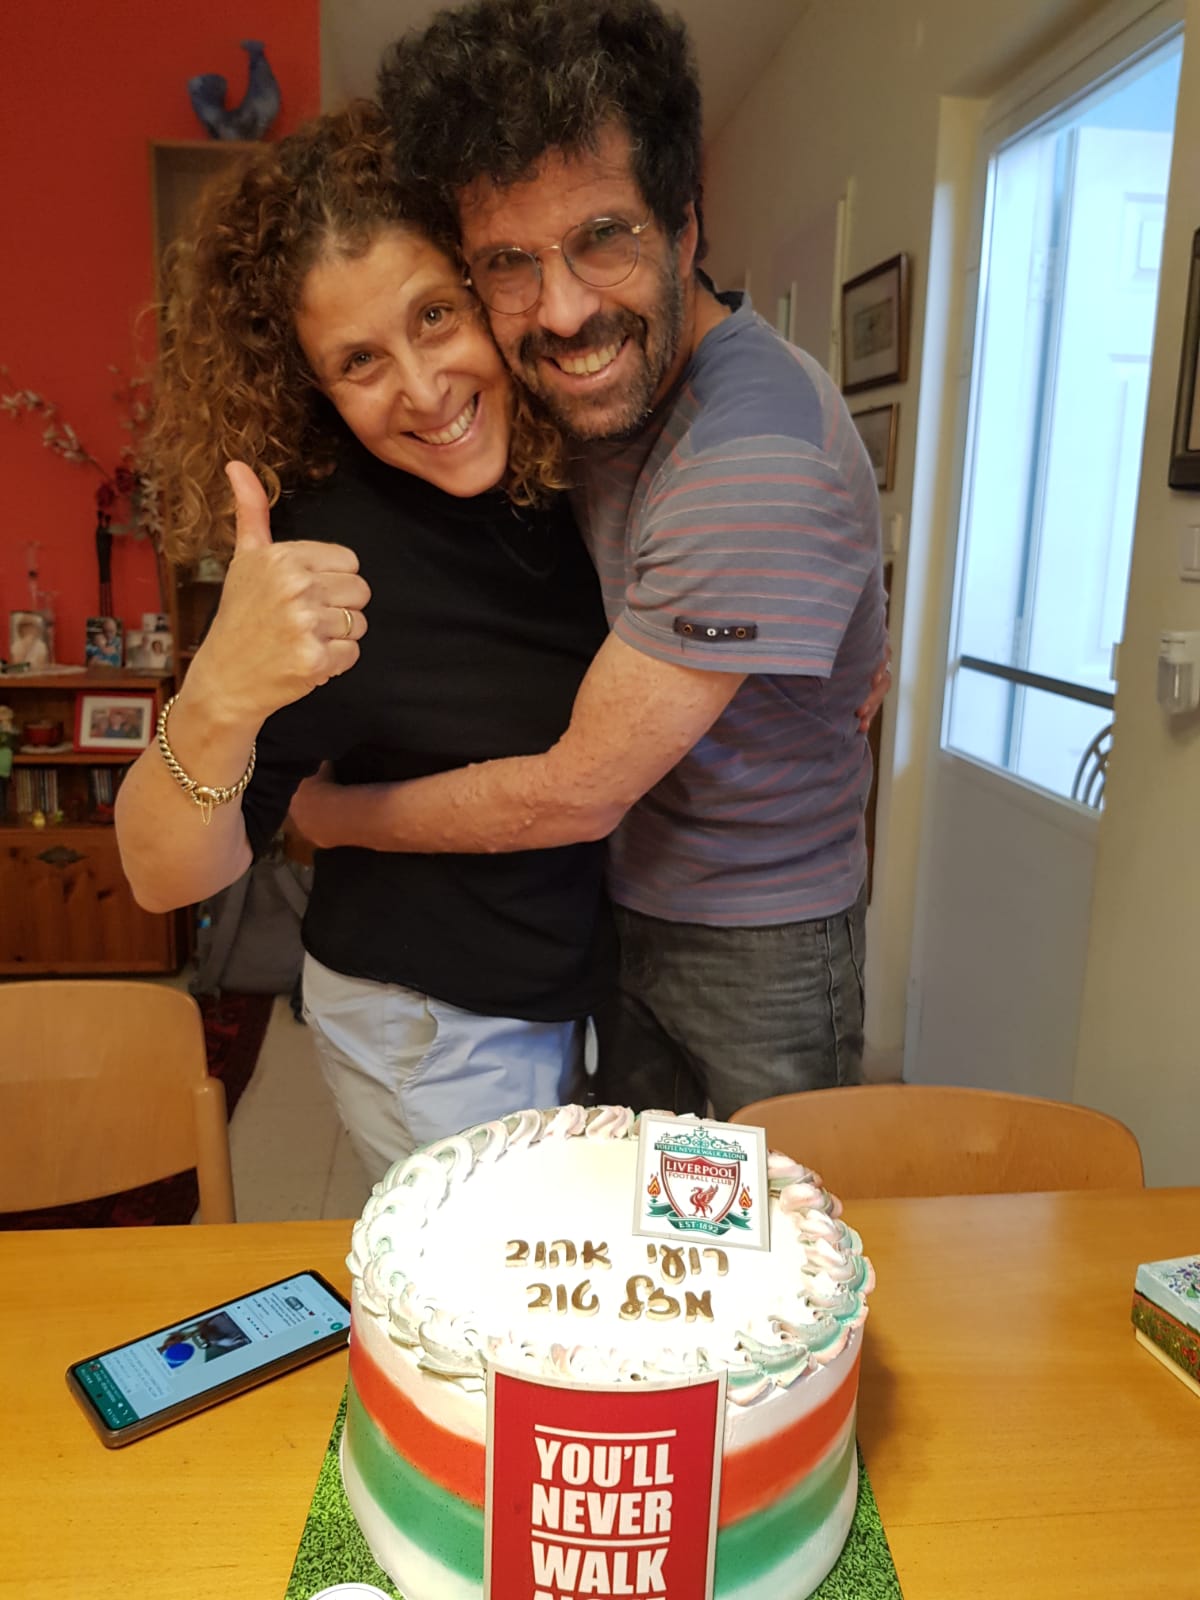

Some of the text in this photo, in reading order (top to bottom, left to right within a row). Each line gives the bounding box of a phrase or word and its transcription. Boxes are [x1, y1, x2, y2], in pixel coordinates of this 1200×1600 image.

[666, 1160, 735, 1178] LIVERPOOL
[702, 1149, 721, 1157] WALK
[722, 1151, 746, 1160] ALONE
[668, 1171, 732, 1186] FOOTBALL CLUB
[505, 1239, 729, 1285] רועי אהוב
[526, 1274, 715, 1323] מזל טוב
[534, 1436, 674, 1488] YOU'LL
[531, 1483, 673, 1535] NEVER
[530, 1540, 669, 1595] WALK
